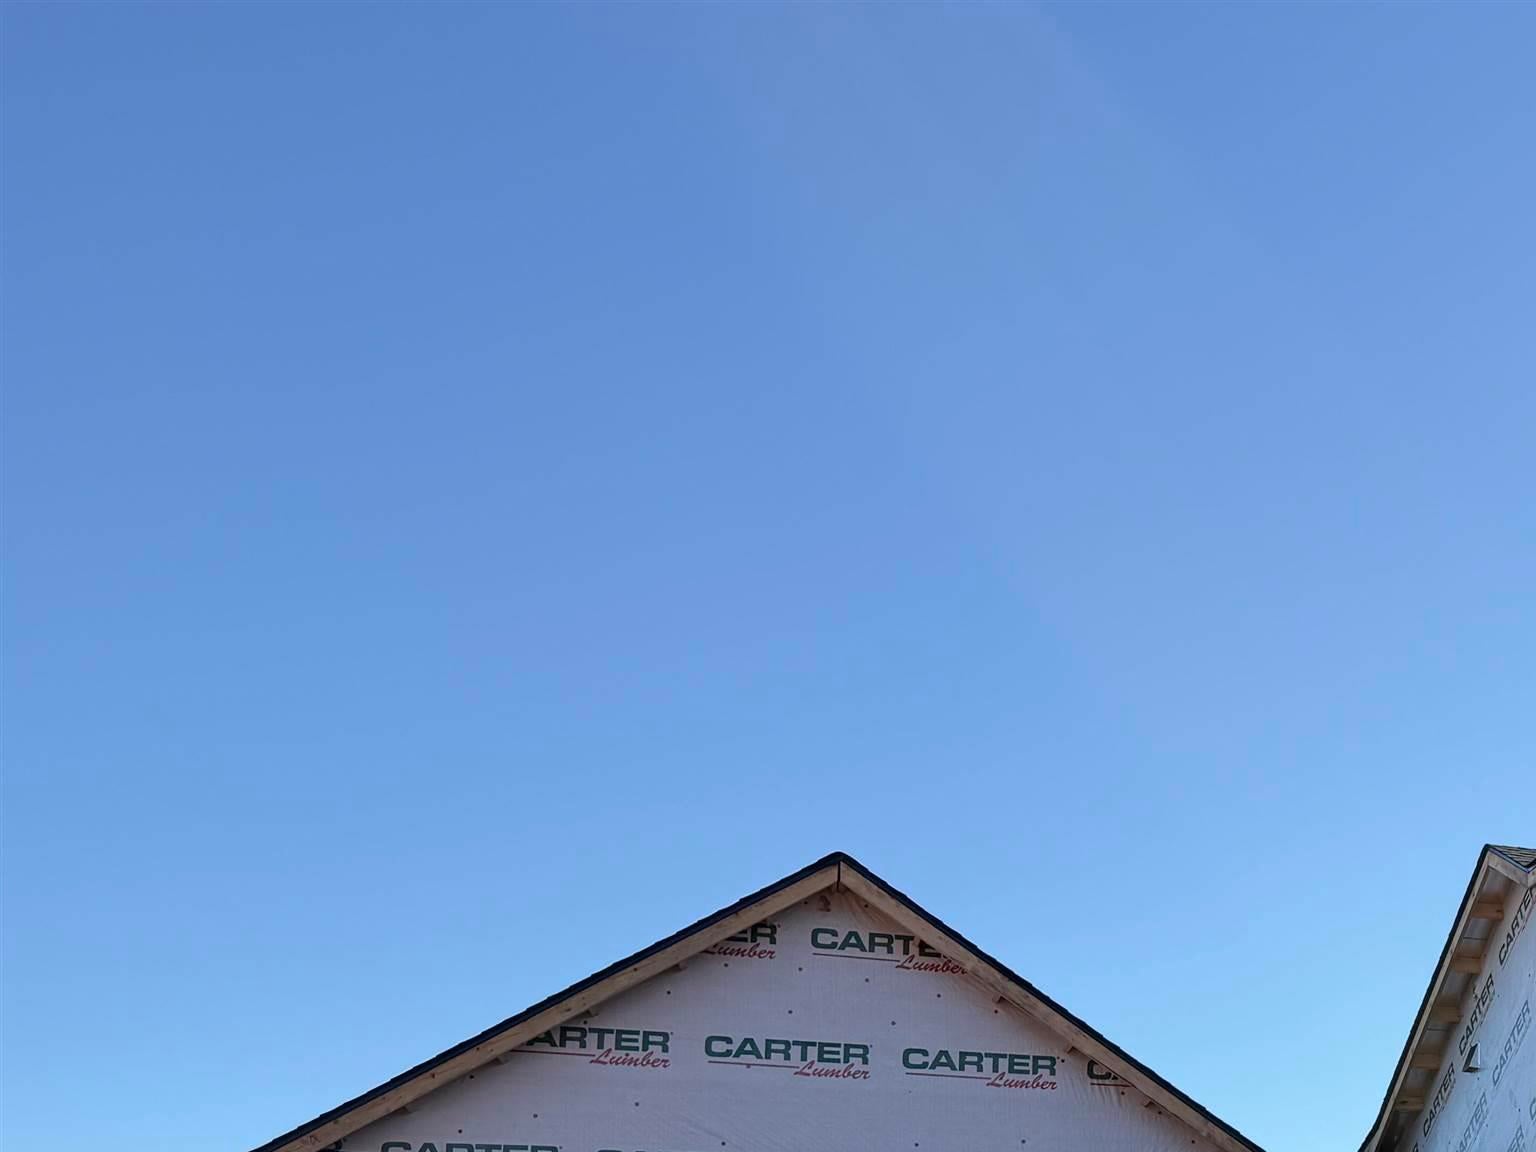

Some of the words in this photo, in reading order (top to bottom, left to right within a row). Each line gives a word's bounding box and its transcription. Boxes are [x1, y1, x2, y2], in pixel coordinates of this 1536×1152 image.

[895, 953, 969, 976] Lumber
[526, 1026, 671, 1053] ARTER
[704, 1034, 870, 1066] CARTER
[902, 1047, 1057, 1077] CARTER
[1492, 1001, 1531, 1087] CARTER
[793, 1059, 871, 1081] Lumber
[986, 1072, 1058, 1091] Lumber
